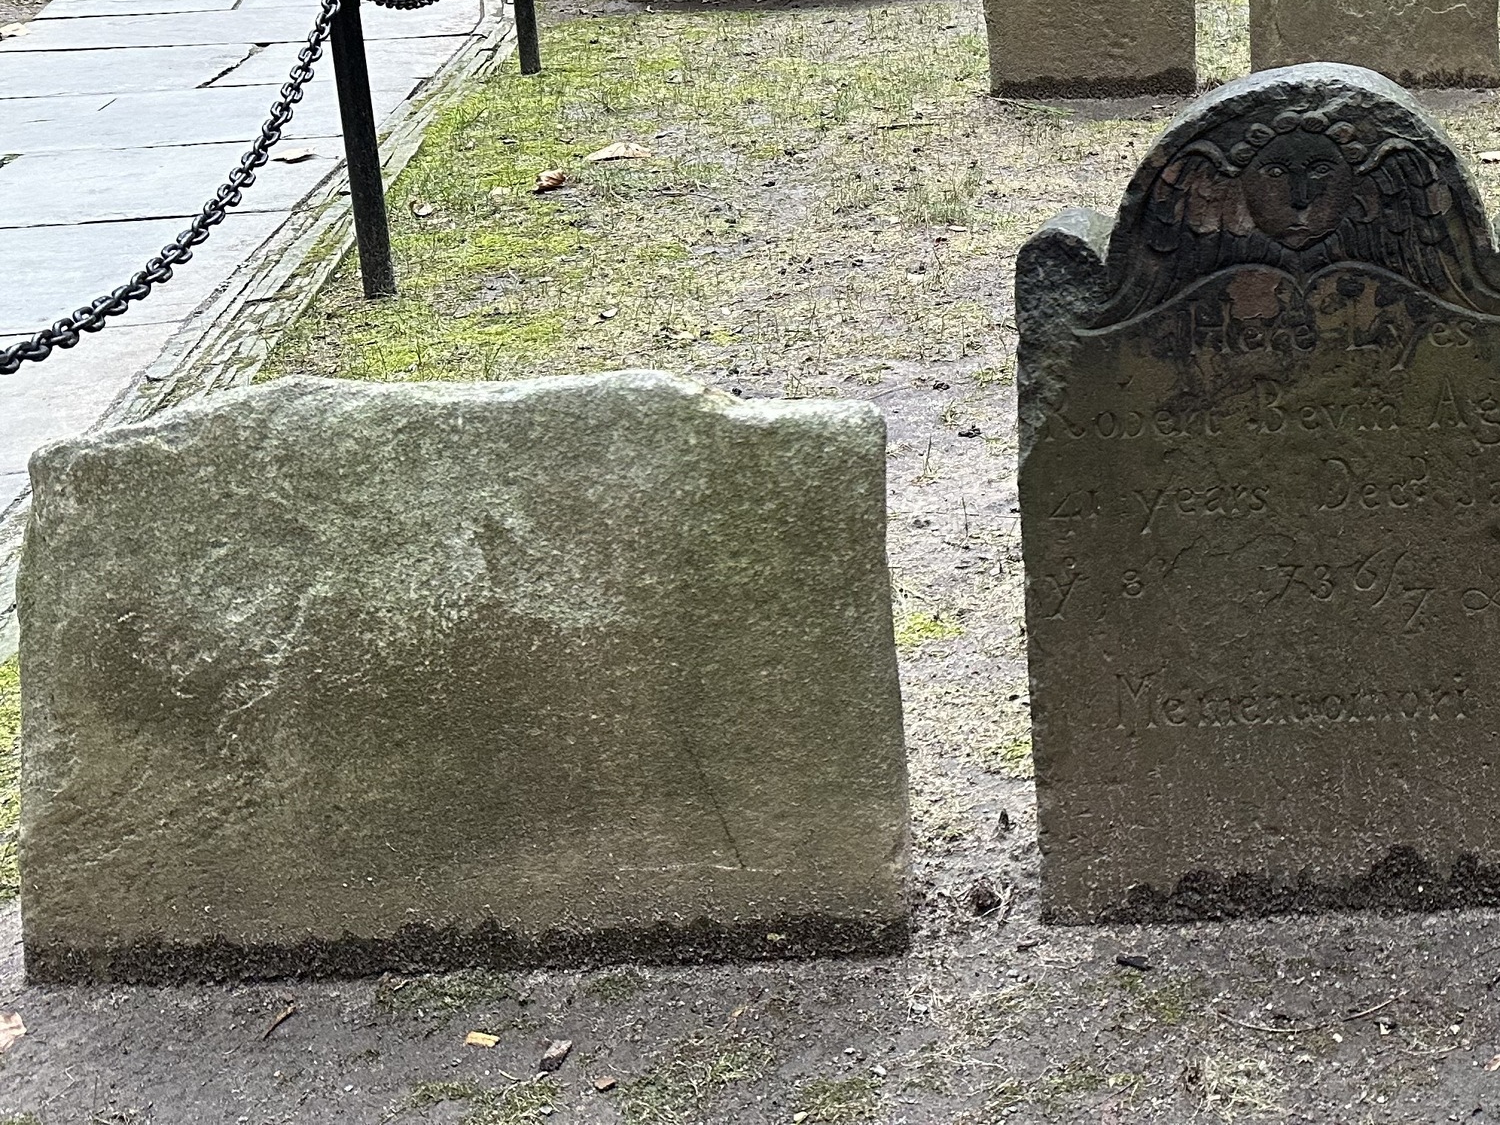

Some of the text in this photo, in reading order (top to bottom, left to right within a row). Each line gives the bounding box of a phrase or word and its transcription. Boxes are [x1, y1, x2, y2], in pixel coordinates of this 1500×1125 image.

[1186, 298, 1477, 374] Here Lyes
[1130, 475, 1271, 535] years
